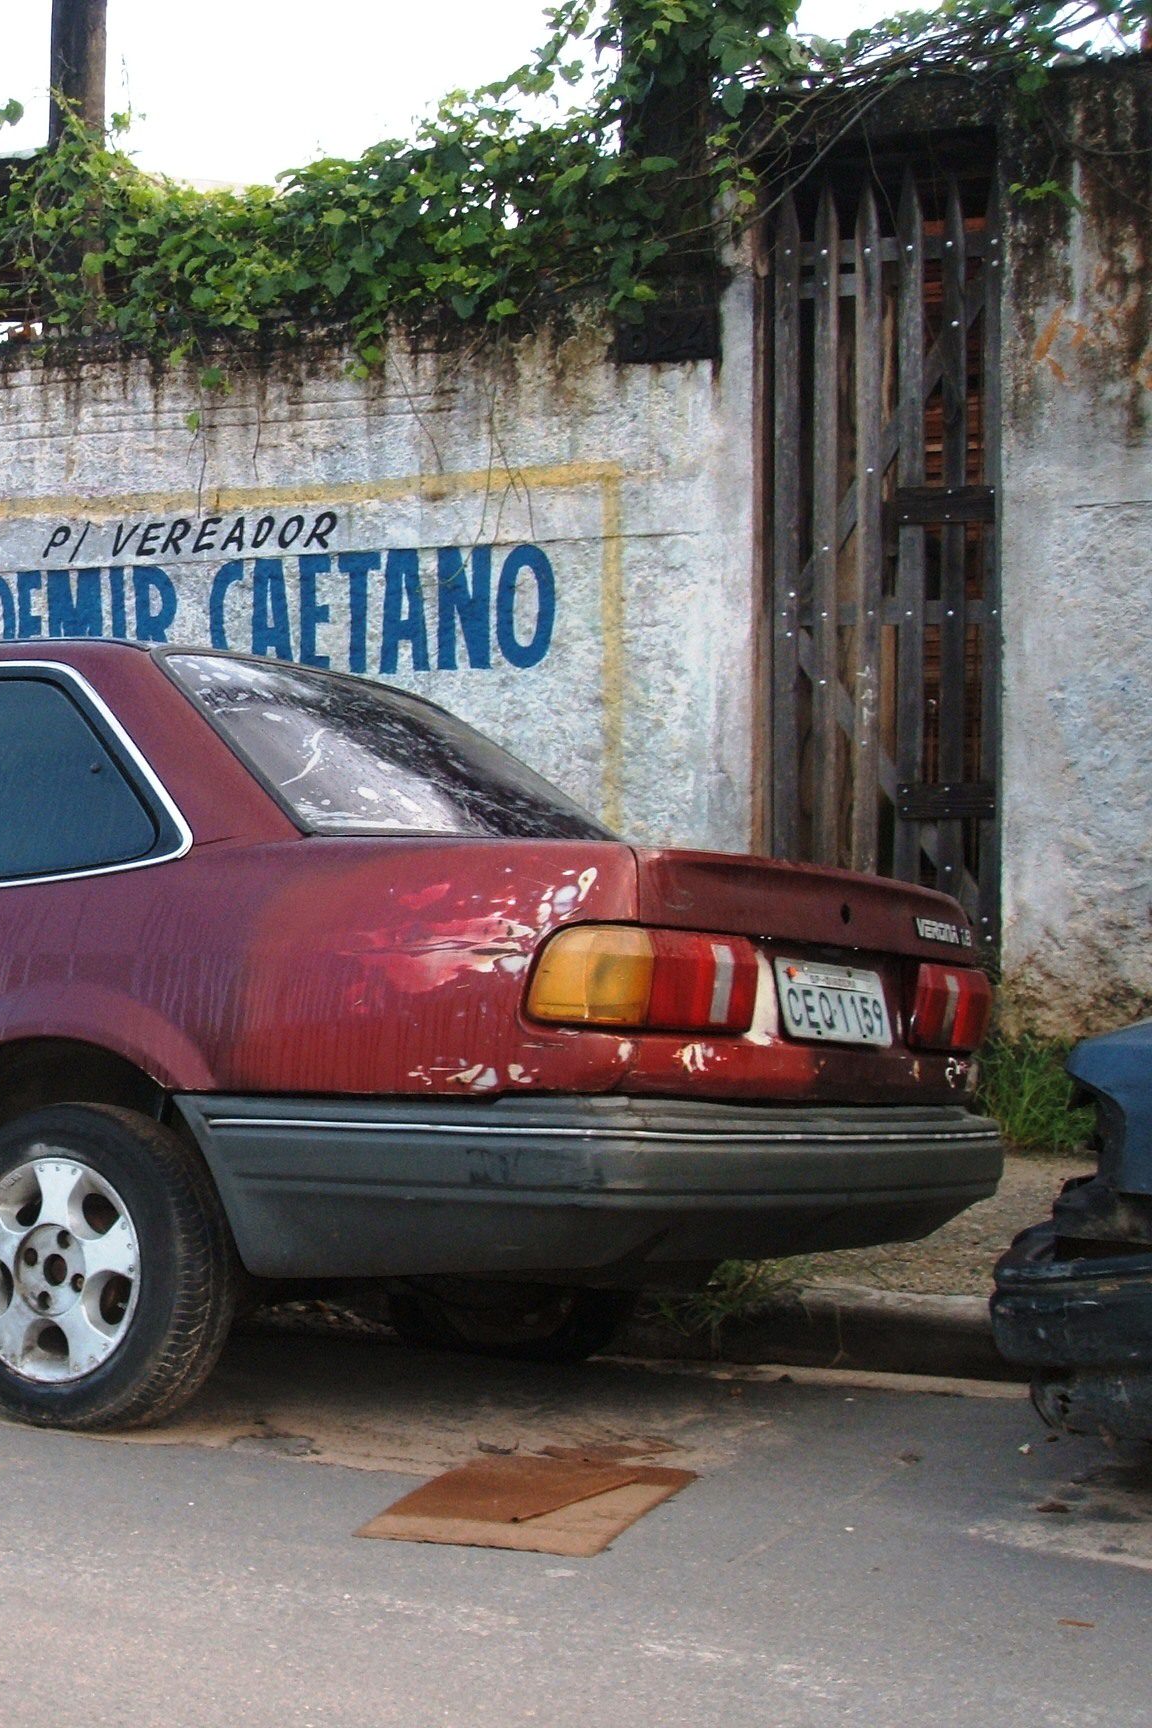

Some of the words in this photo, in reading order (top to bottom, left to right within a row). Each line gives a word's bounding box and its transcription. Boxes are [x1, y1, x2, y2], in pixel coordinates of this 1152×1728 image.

[42, 520, 92, 564] P/
[111, 510, 339, 558] VEREADOR
[209, 544, 556, 675] CAETANO
